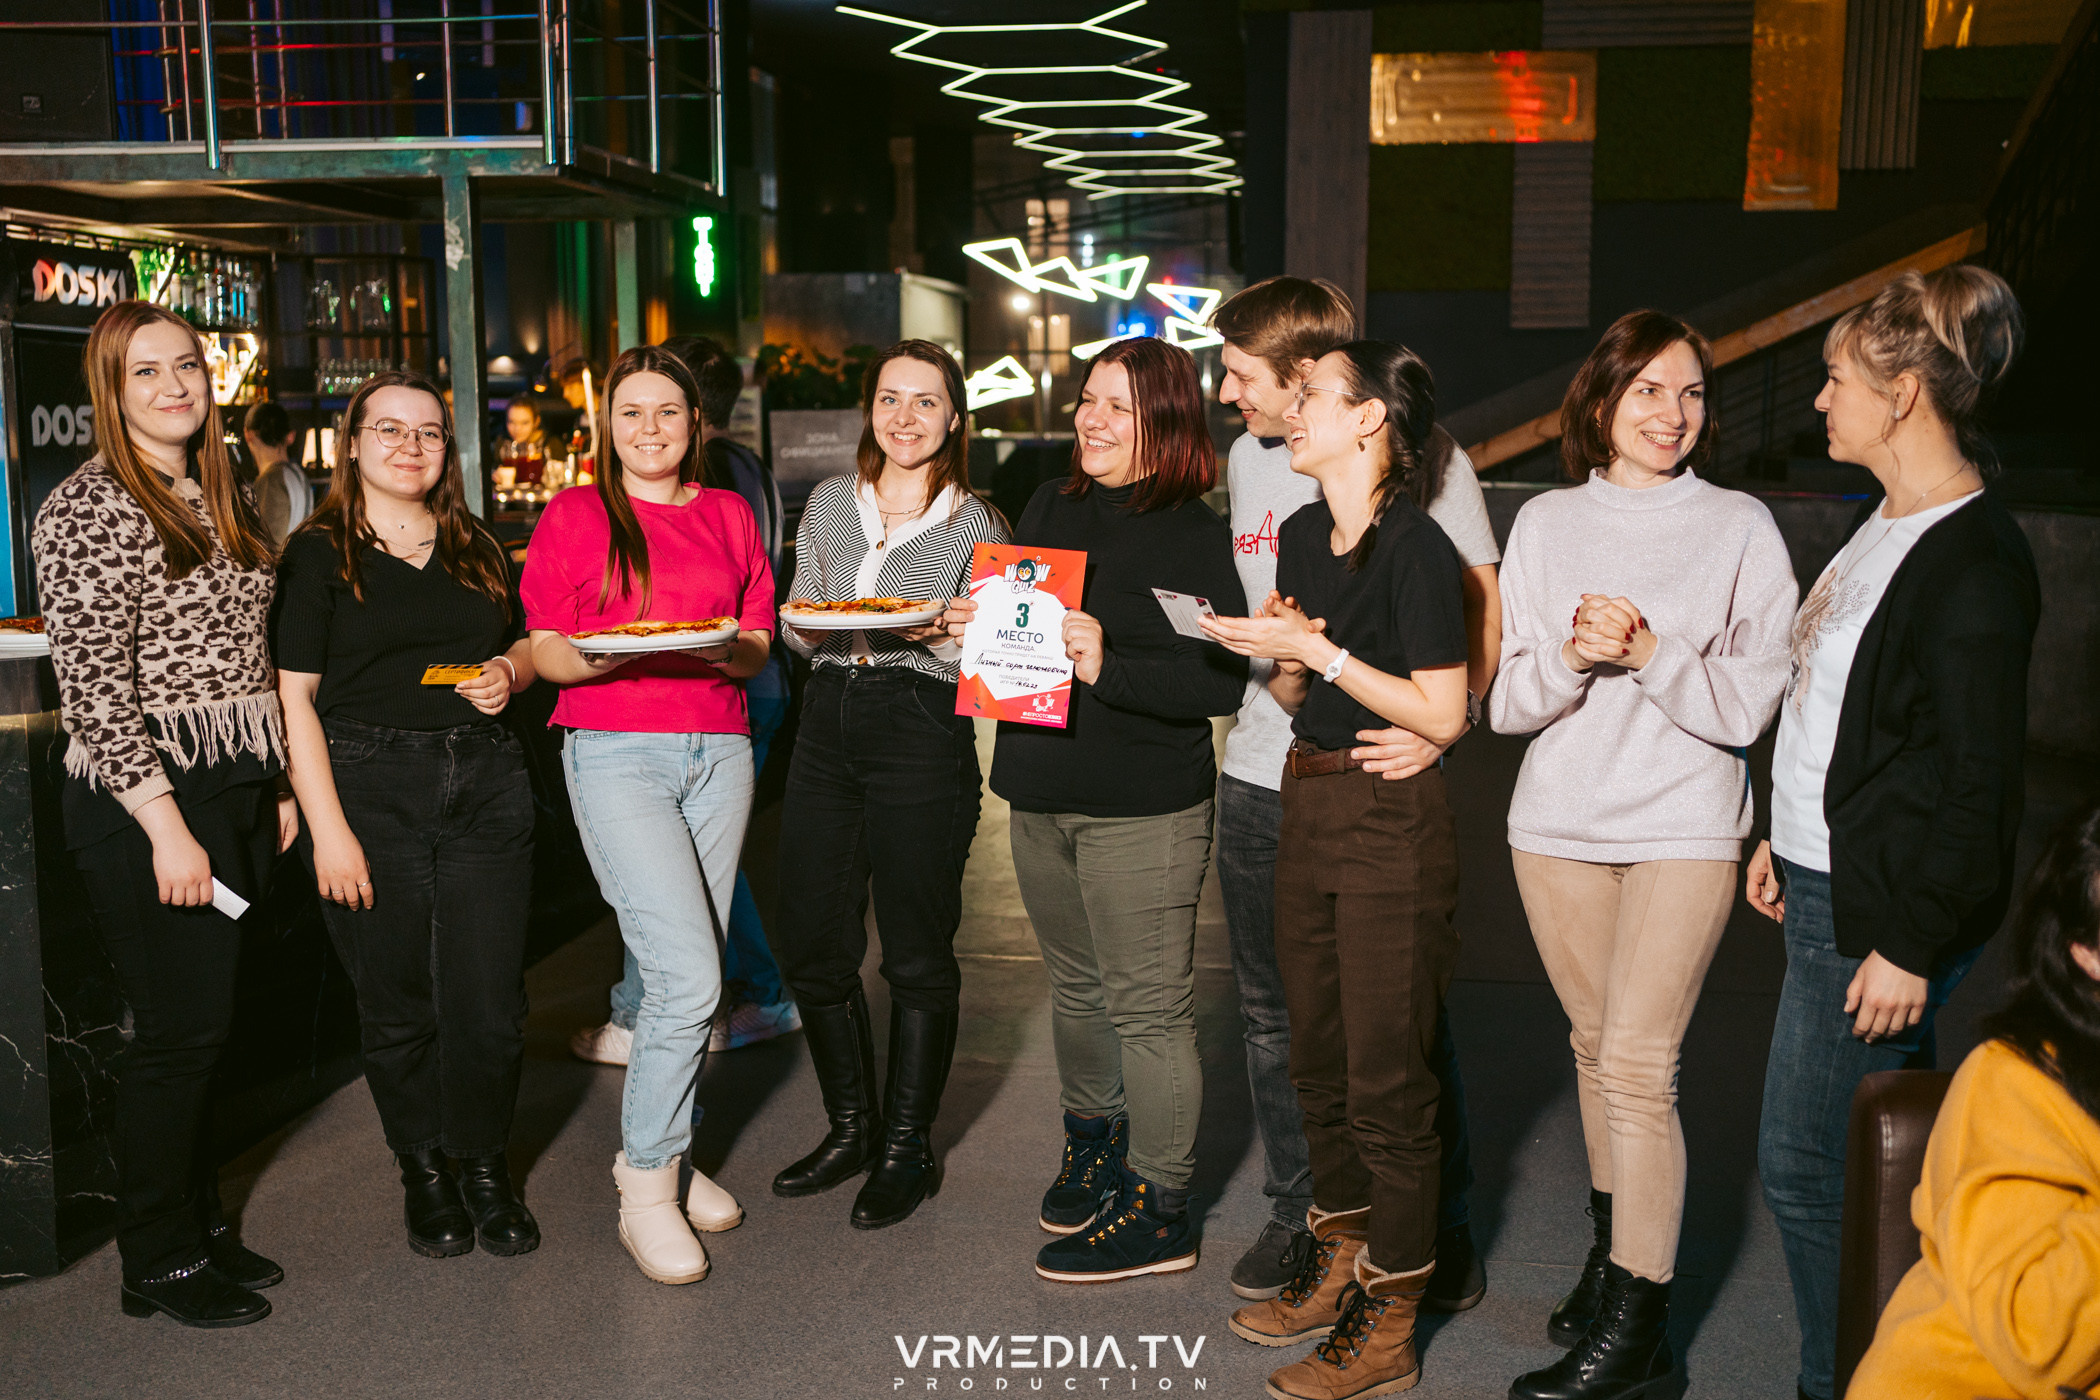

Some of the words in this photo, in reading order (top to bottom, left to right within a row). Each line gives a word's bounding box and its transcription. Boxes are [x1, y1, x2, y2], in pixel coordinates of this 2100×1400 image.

[32, 258, 127, 308] DOSKI
[31, 403, 96, 447] DOS
[1003, 559, 1052, 582] WOW
[1011, 580, 1037, 594] QUIZ
[1015, 603, 1030, 628] 3
[996, 629, 1044, 644] МЕСТО
[1001, 642, 1036, 652] КОМАНДА
